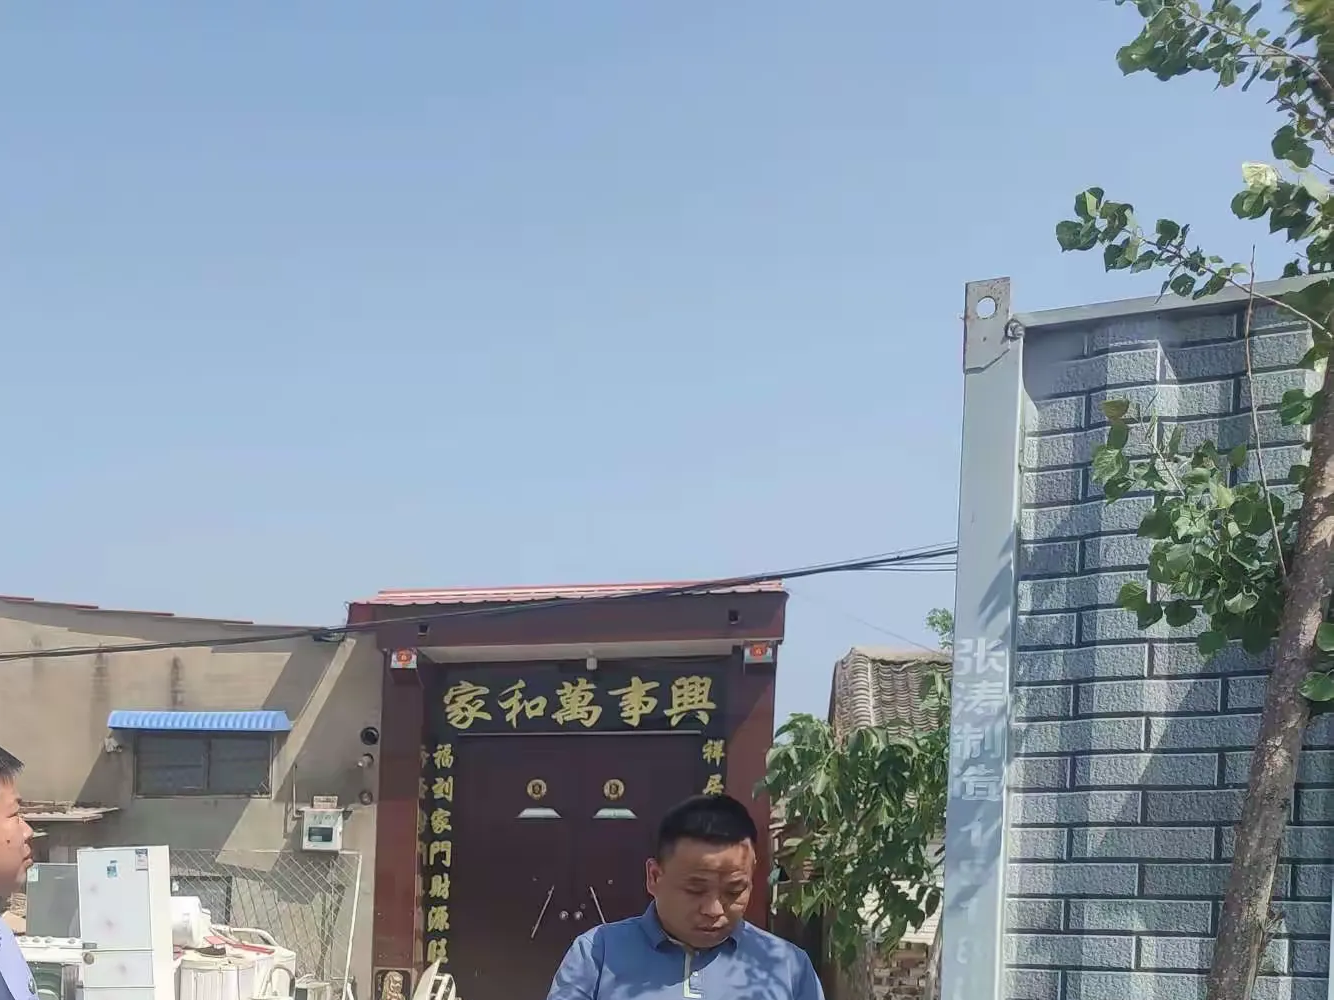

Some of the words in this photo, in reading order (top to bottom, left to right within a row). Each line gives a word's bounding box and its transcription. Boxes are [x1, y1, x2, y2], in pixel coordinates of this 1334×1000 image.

[442, 676, 717, 729] 家和萬事興
